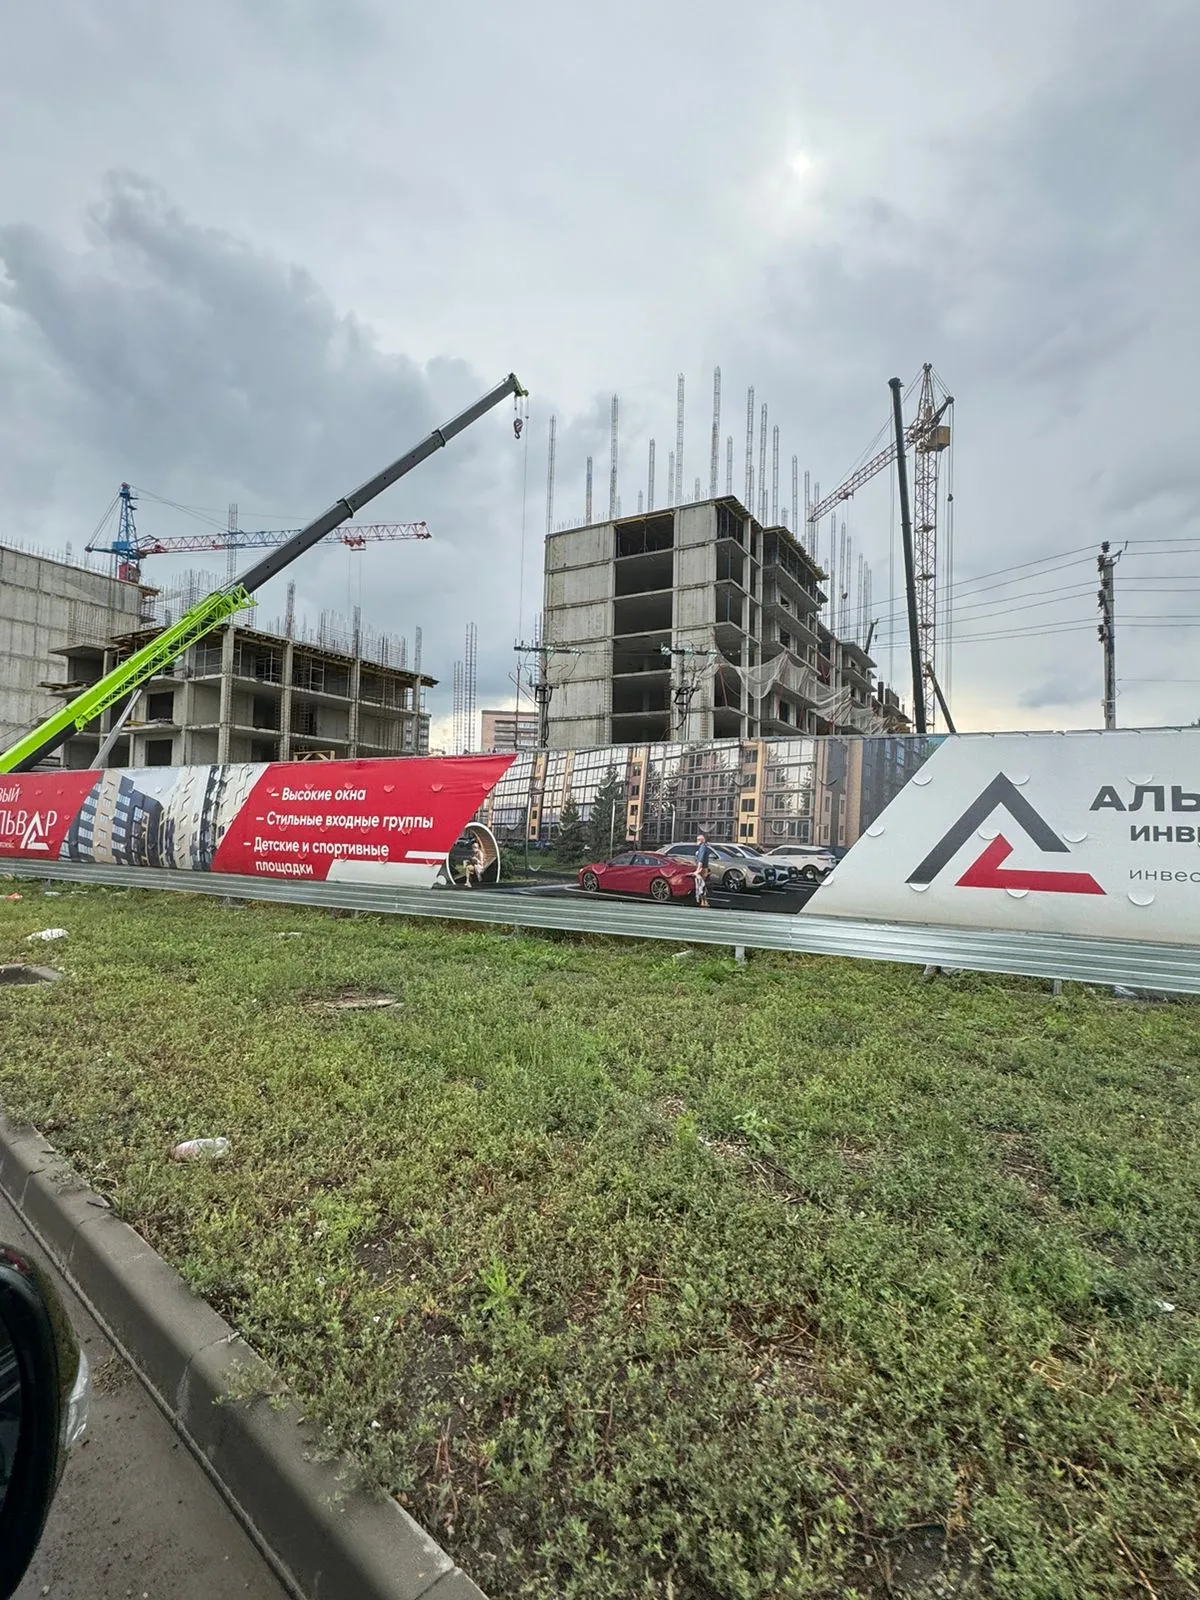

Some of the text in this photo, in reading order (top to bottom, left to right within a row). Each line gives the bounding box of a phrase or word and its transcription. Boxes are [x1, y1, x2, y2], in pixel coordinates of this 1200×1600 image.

[281, 787, 332, 801] Высокие
[334, 788, 367, 801] окна
[266, 811, 323, 827] Стильные
[325, 815, 380, 829] входные
[382, 815, 434, 832] группы
[1130, 825, 1200, 843] ИНВ
[254, 837, 300, 854] Детские
[302, 841, 310, 852] и
[312, 842, 390, 858] спортивные
[255, 860, 314, 876] площадки
